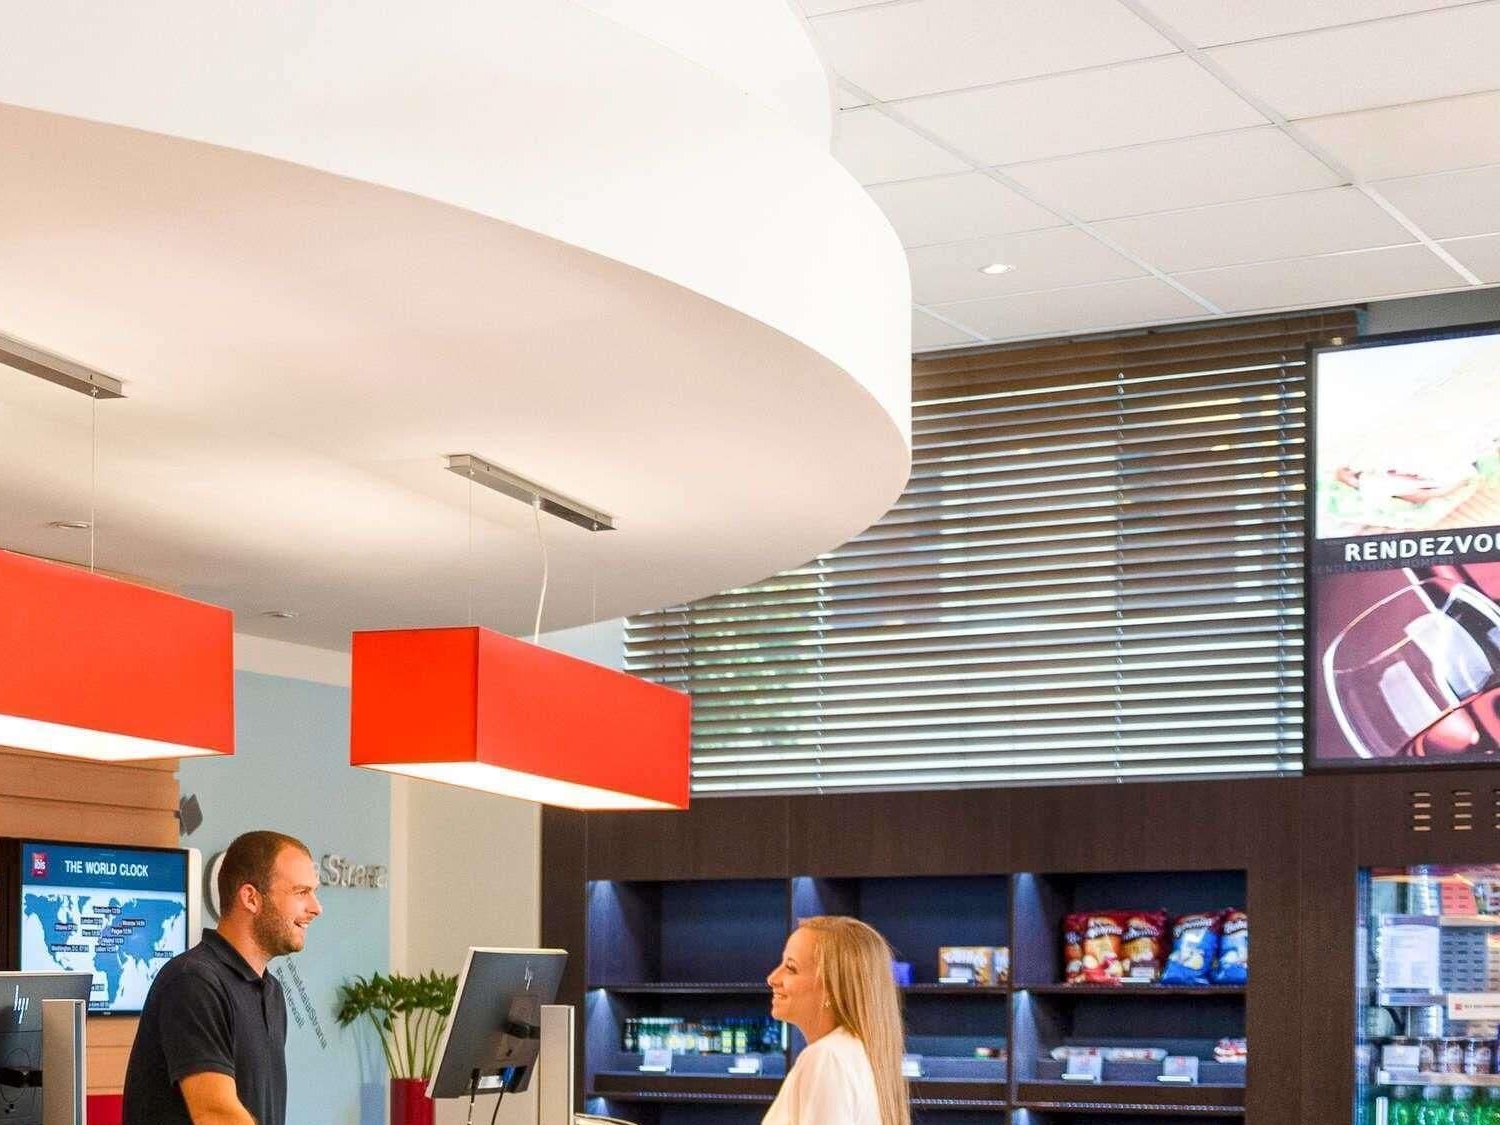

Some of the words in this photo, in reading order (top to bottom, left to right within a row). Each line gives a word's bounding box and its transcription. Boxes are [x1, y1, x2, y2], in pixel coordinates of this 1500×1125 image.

[1344, 533, 1500, 562] RENDEZVO
[65, 860, 83, 874] THE
[85, 861, 117, 875] WORLD
[119, 863, 149, 877] CLOCK
[13, 984, 30, 1025] hp
[285, 955, 328, 1050] rahaMalaStrana
